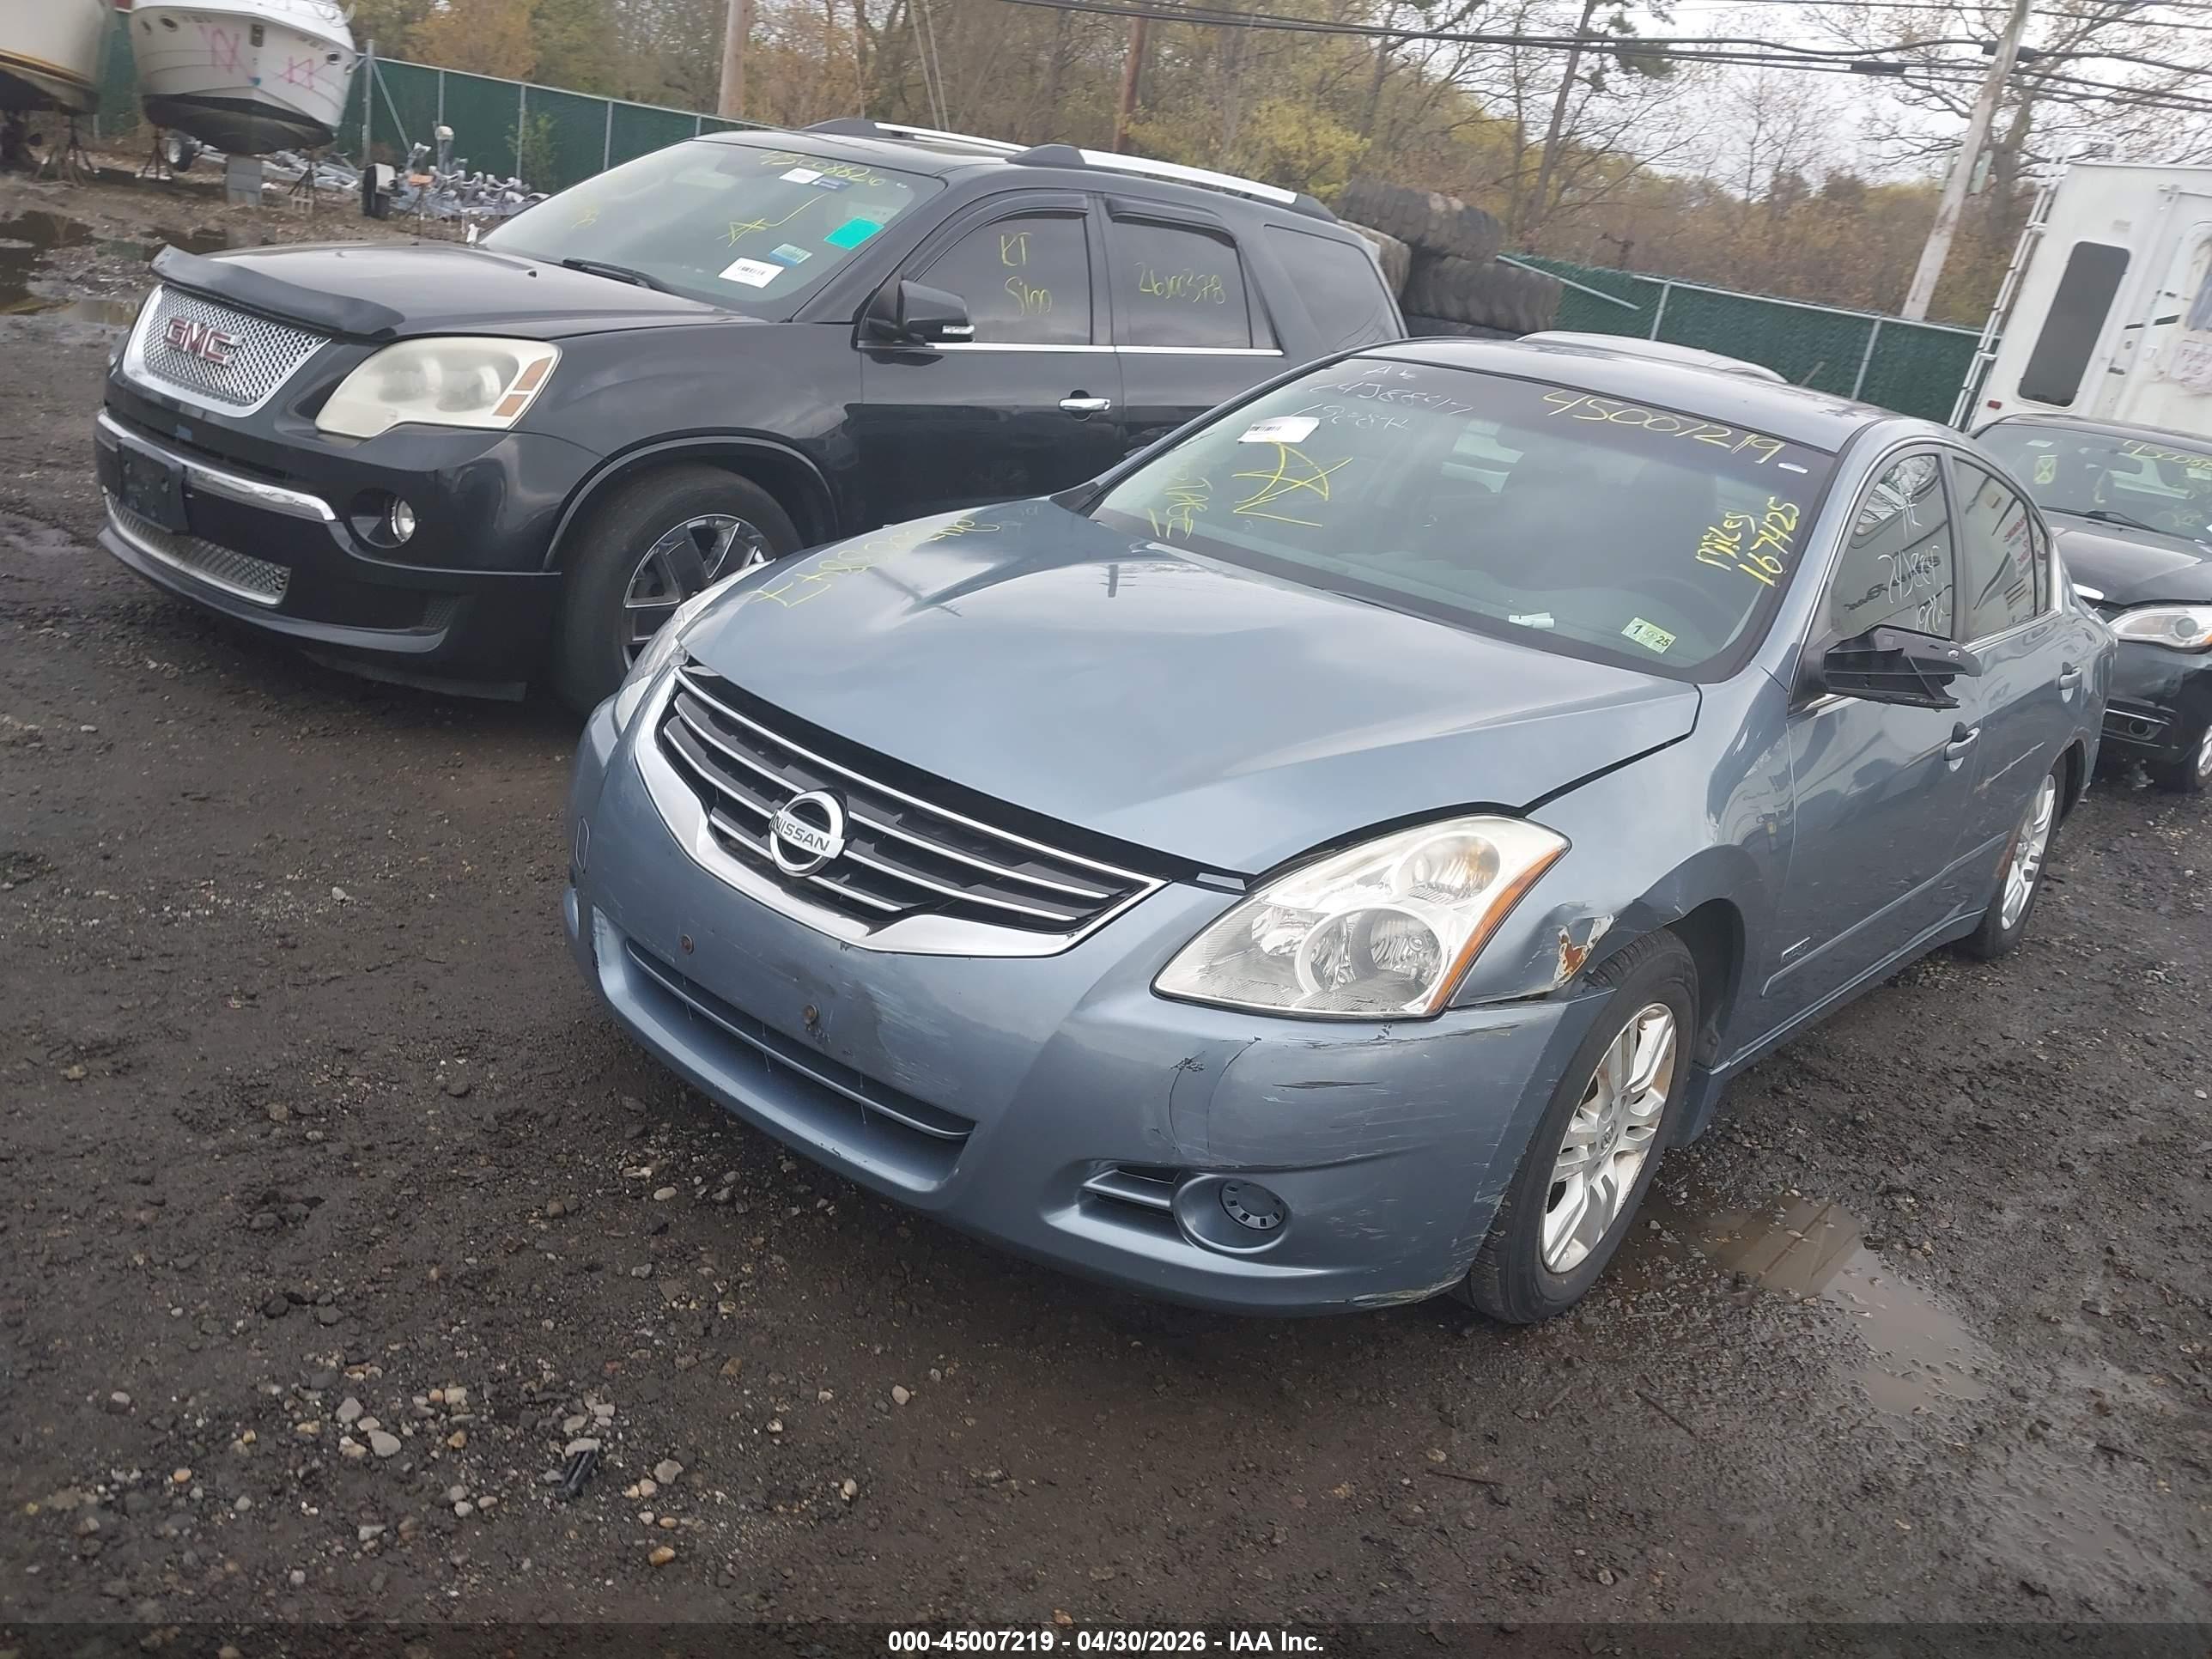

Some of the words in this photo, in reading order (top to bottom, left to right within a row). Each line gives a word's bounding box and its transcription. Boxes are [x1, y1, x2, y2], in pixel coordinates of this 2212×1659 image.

[166, 315, 236, 365] GMC
[1542, 389, 1787, 465] 45007219
[1737, 495, 1801, 587] 167425
[1633, 624, 1643, 635] 1
[1656, 635, 1671, 647] 25
[773, 814, 830, 852] NISSAN
